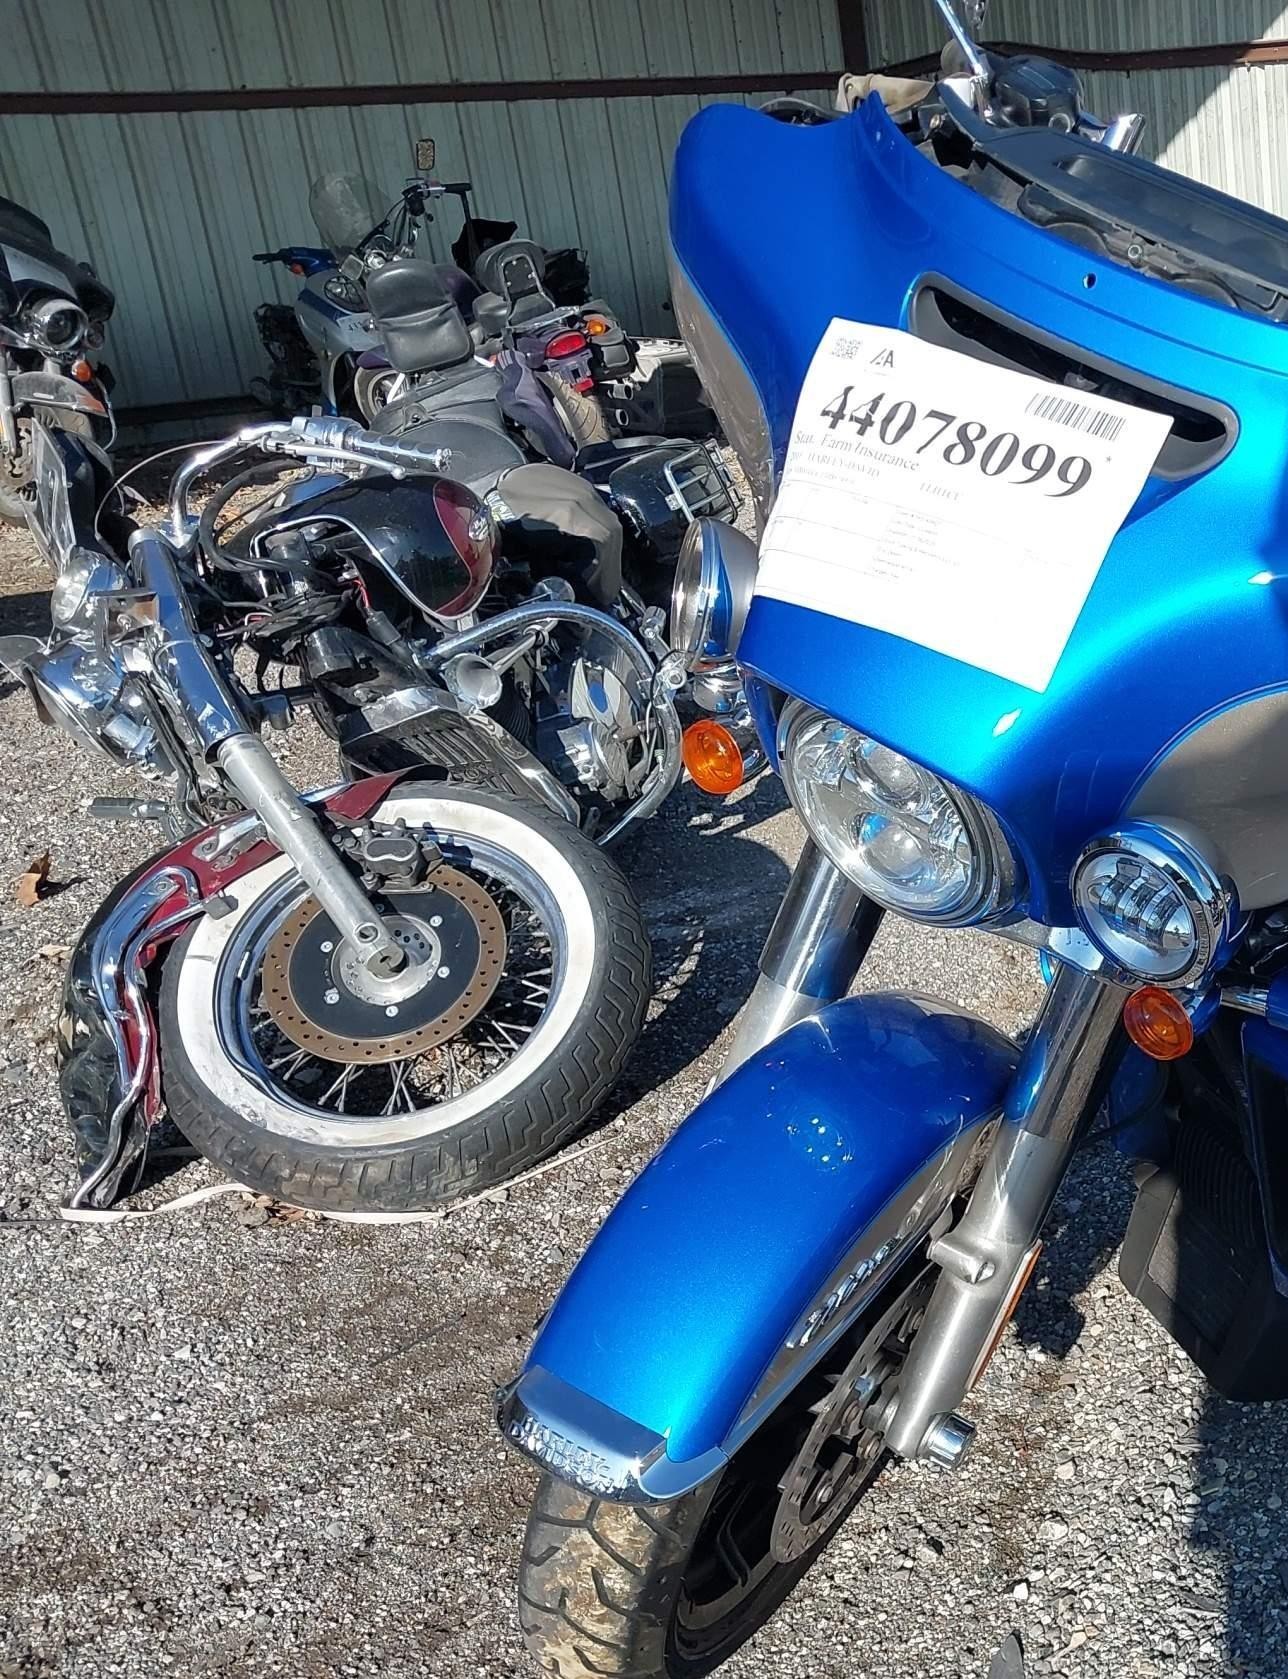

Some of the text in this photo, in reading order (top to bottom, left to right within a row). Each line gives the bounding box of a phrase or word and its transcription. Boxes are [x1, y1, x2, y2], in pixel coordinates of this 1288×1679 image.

[820, 385, 1092, 497] 44078099
[820, 434, 853, 452] Farm
[854, 441, 919, 471] Insurance
